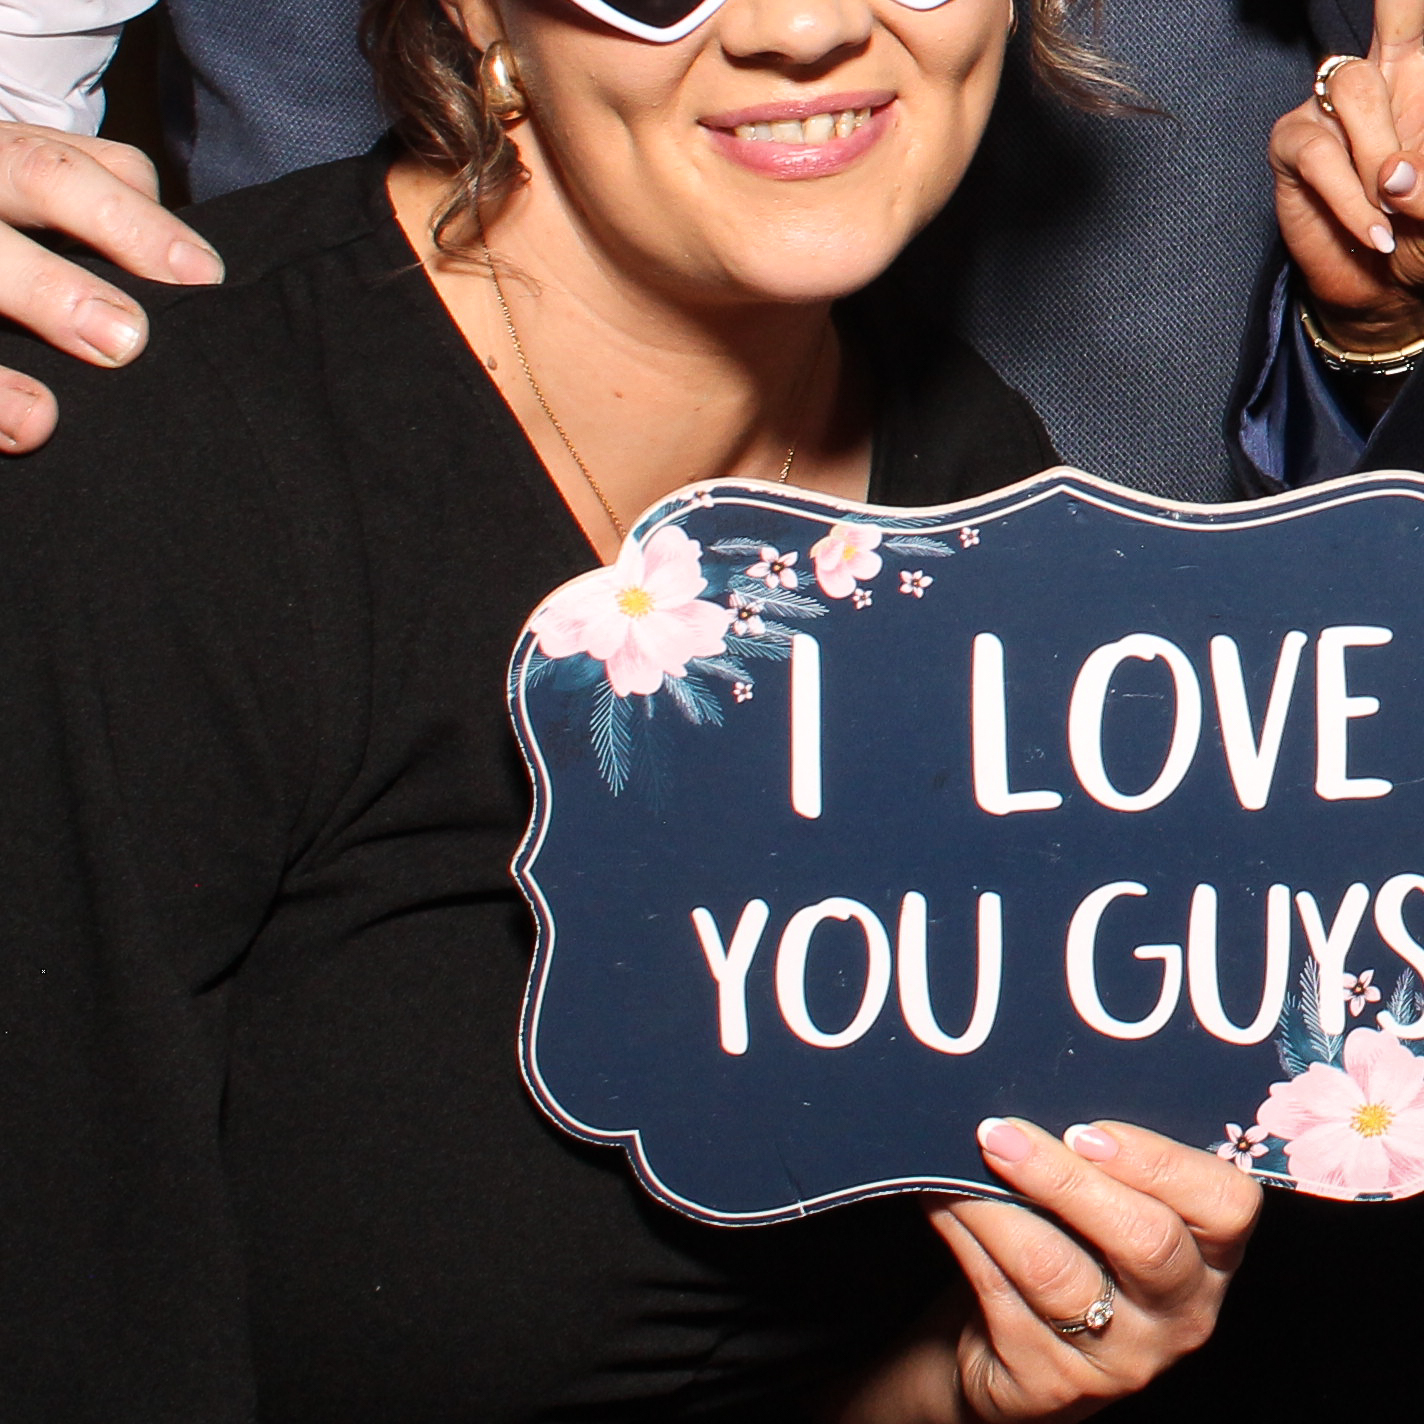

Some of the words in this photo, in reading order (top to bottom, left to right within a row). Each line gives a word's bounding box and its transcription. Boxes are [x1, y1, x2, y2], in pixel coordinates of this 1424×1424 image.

[790, 631, 821, 819] I
[971, 625, 1393, 815] LOVE
[691, 891, 1002, 1055] YOU
